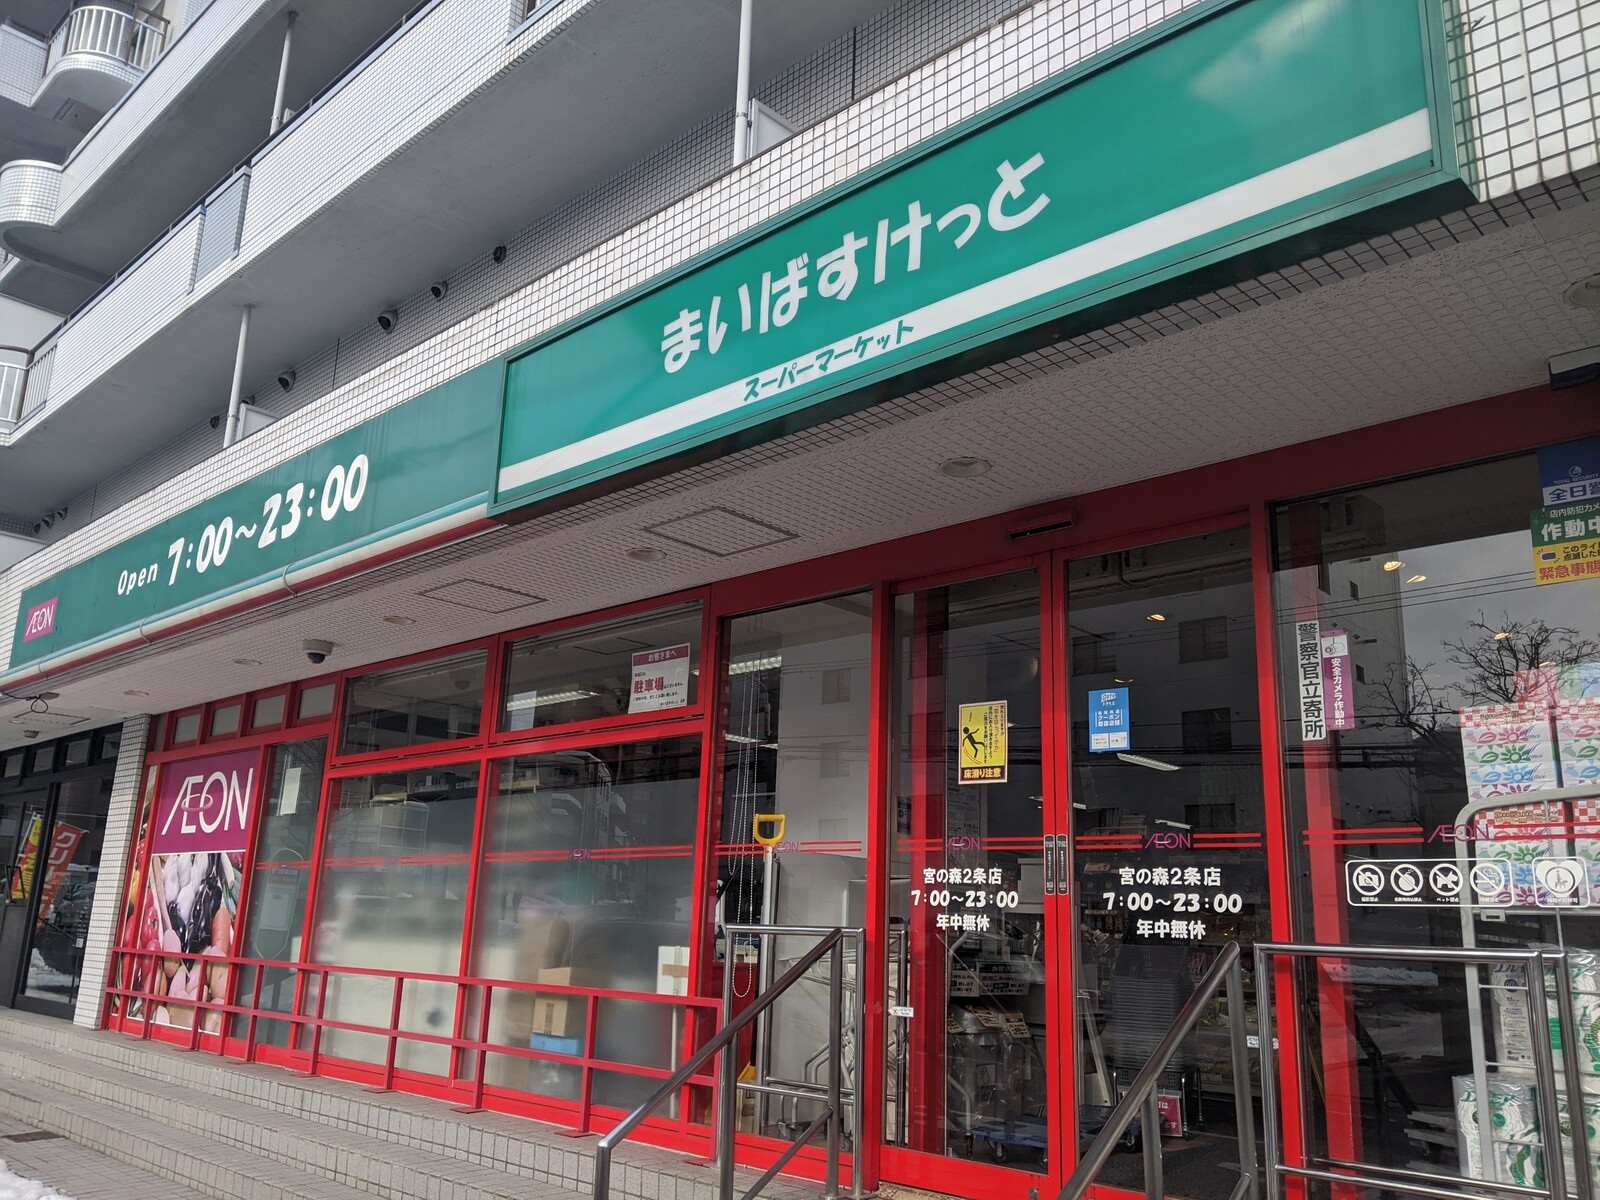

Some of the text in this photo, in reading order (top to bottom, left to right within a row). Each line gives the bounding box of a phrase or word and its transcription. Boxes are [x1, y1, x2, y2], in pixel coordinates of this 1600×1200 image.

[660, 152, 1051, 373] まいばすけっと
[742, 320, 914, 402] スーパーマーケット
[117, 562, 159, 596] Open
[1297, 622, 1324, 740] 警察官立寄所
[1331, 658, 1345, 728] 安全カメラ作動中
[964, 768, 1001, 779] 床滑り注意
[923, 867, 1003, 885] 宮の森2条店
[1118, 867, 1222, 887] 宮の森2条店
[936, 913, 991, 932] 年中無休
[1136, 918, 1207, 940] 年中無休
